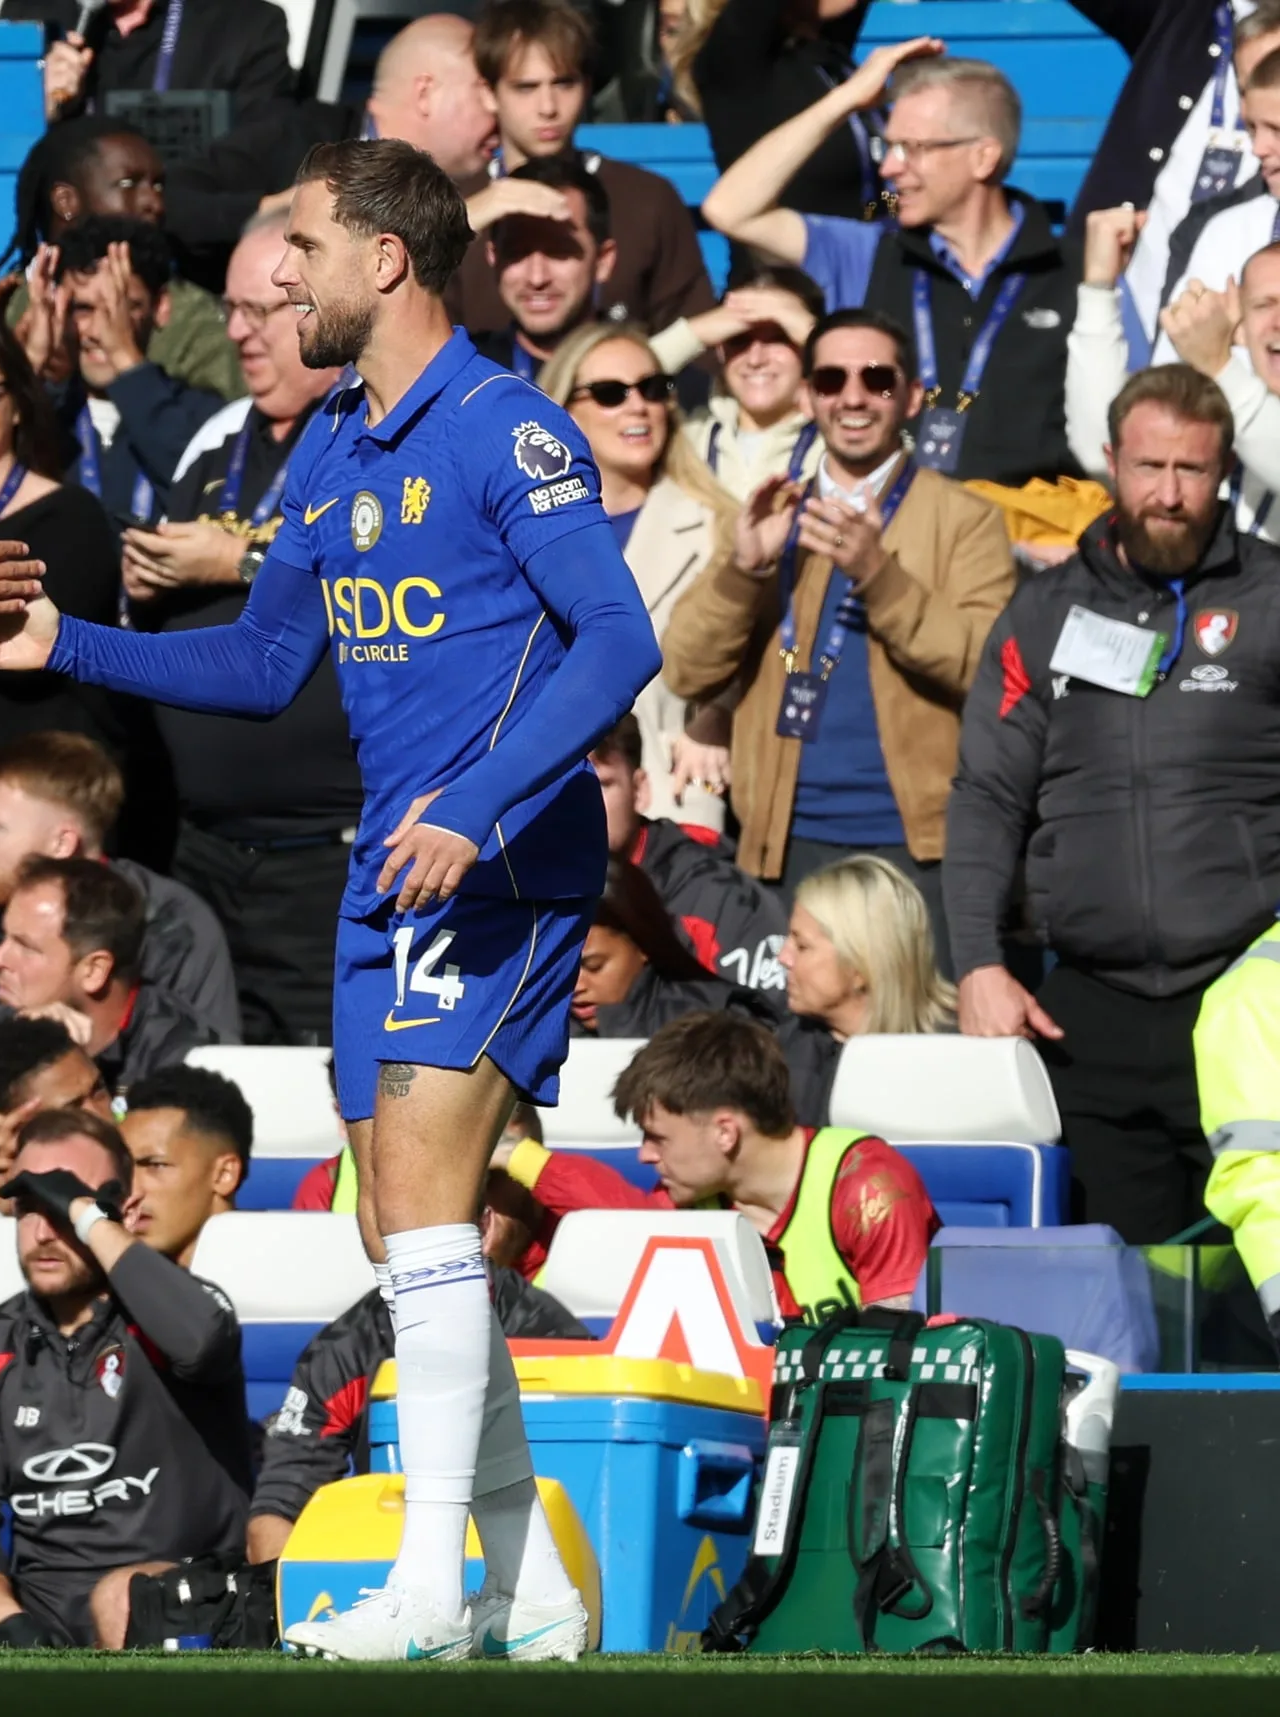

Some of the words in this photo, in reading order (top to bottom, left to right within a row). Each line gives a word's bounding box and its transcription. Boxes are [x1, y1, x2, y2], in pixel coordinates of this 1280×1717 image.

[528, 489, 550, 504] No
[549, 477, 583, 497] room
[532, 498, 552, 515] for
[551, 487, 589, 507] racism
[351, 643, 410, 662] CIRCLE
[393, 926, 465, 1011] 14
[10, 1466, 160, 1516] CHERY
[764, 1455, 789, 1541] Stadium
